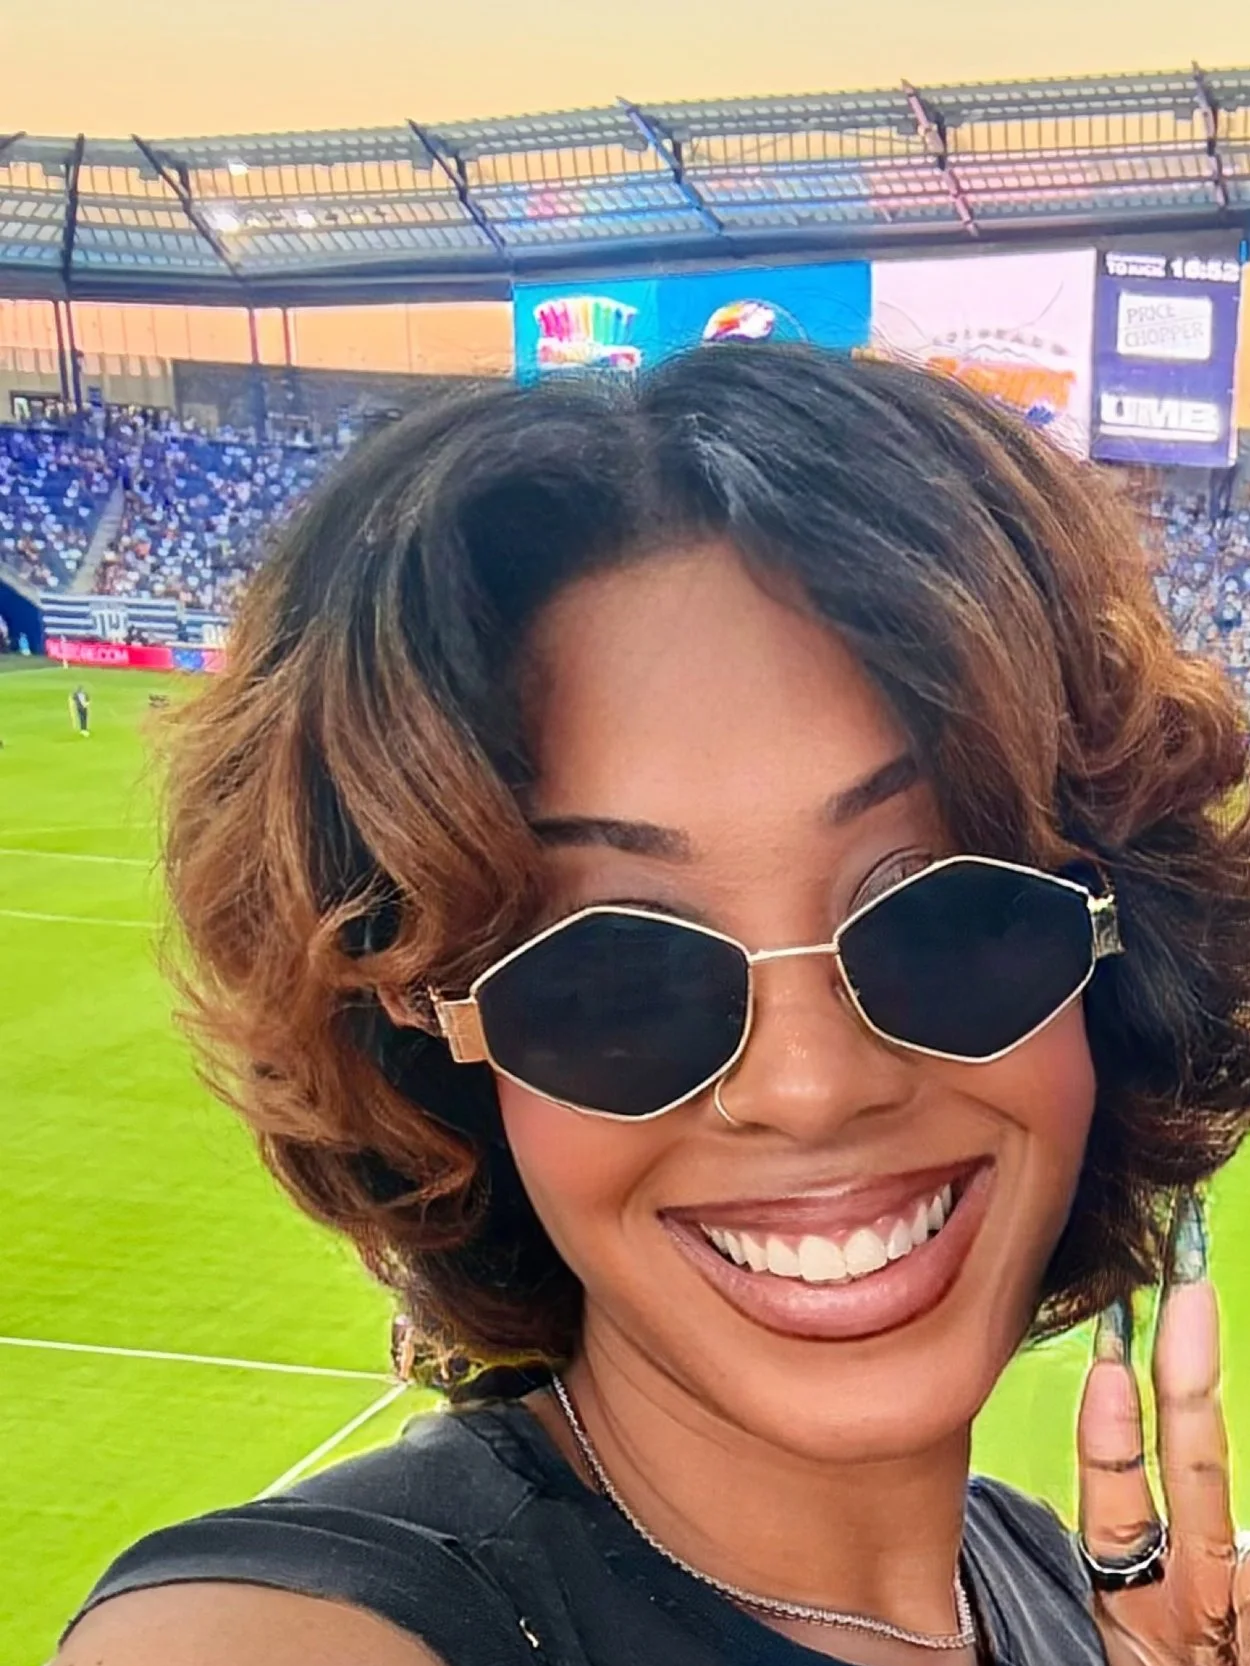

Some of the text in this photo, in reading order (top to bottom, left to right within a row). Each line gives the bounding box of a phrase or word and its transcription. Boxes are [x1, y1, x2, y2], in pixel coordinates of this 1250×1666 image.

[1127, 302, 1177, 324] PRICE
[1124, 321, 1205, 348] CHOPPER
[1100, 392, 1220, 432] UMB
